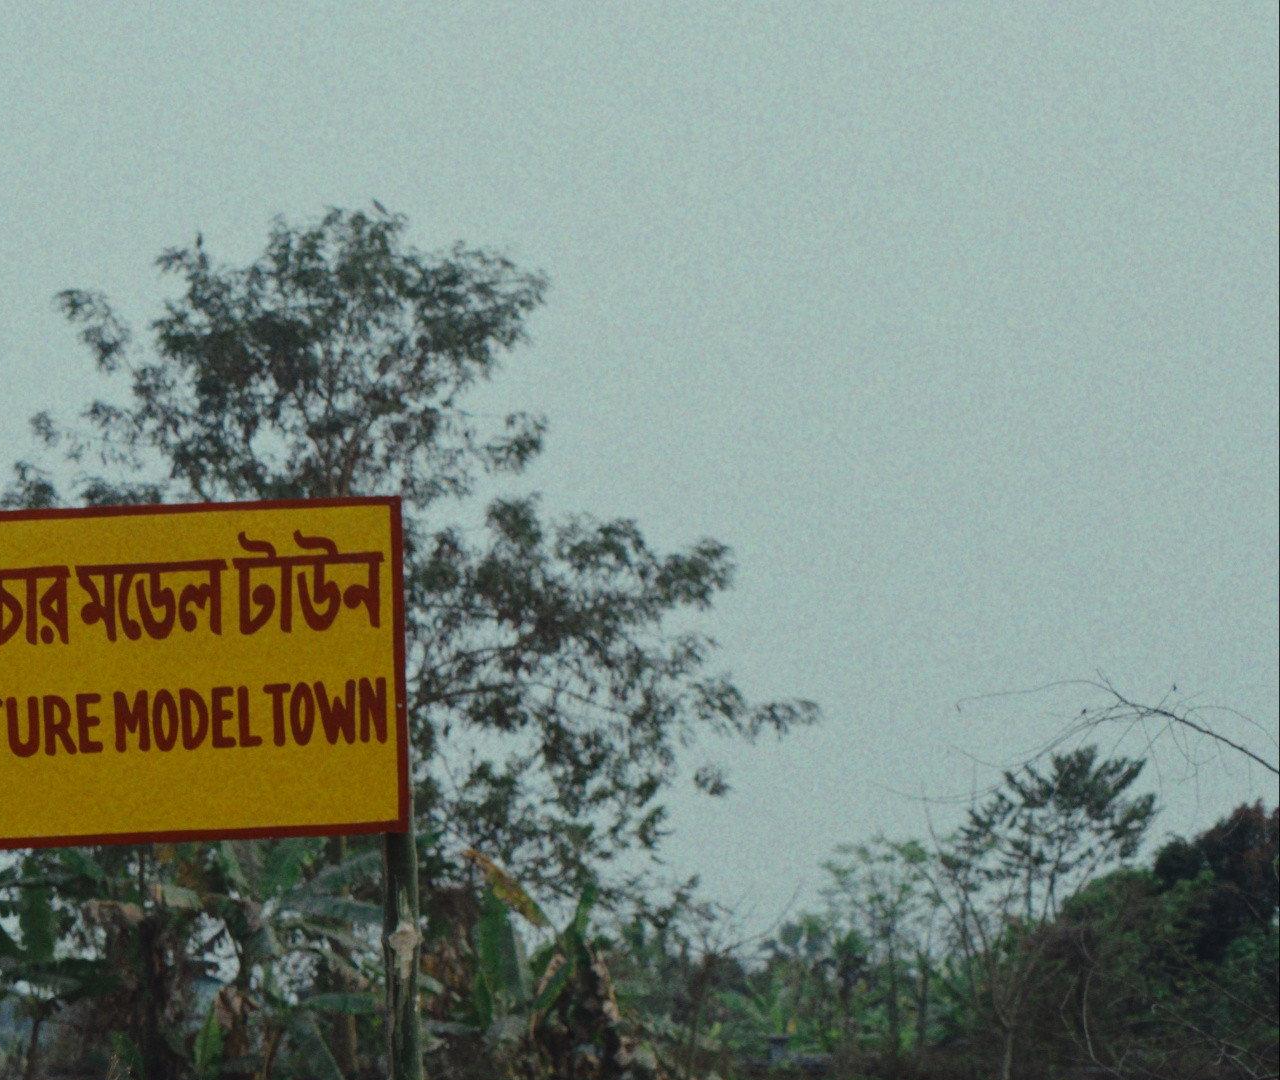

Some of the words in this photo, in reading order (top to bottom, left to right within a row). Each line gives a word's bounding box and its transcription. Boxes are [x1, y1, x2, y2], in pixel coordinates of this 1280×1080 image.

[75, 558, 228, 643] মডেল
[232, 529, 385, 636] টাউন
[112, 685, 263, 753] MODEL
[262, 676, 388, 748] TOWN
